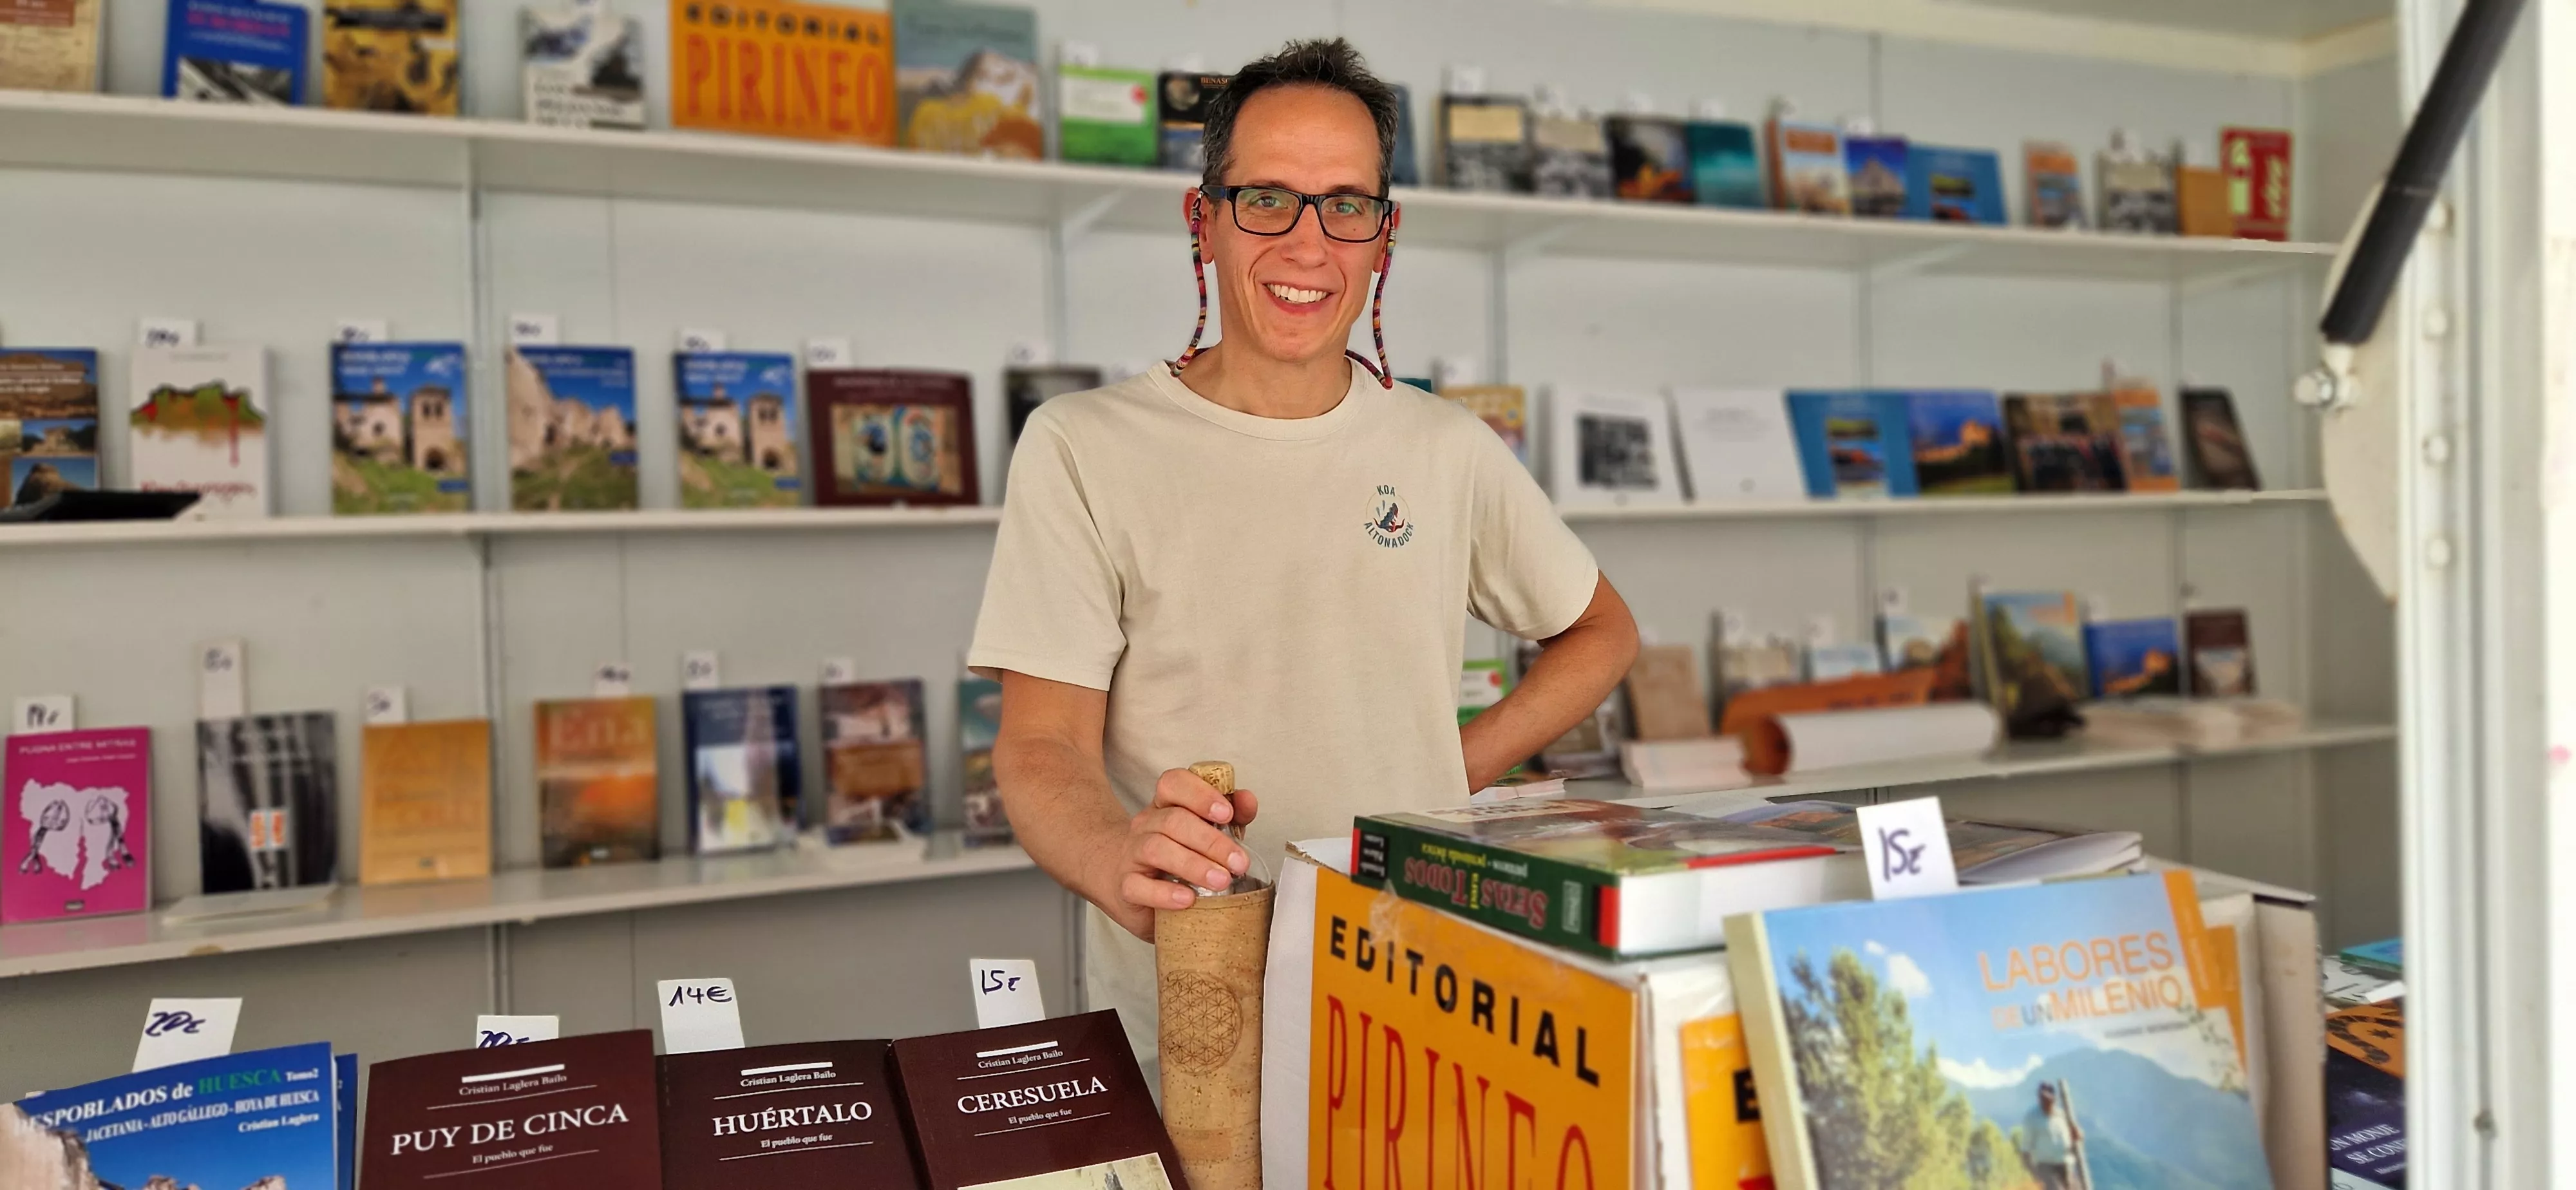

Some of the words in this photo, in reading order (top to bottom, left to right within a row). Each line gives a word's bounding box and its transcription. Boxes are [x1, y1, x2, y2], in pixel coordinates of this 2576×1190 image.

[686, 2, 882, 47] EDITORIAL
[687, 34, 886, 137] PIRINEO
[1376, 484, 1396, 496] KOA
[1363, 522, 1414, 548] ALTONADOCK
[1978, 930, 2175, 992] LABORES
[668, 985, 732, 1007] 14€
[1331, 915, 1599, 1088] EDITORIAL
[978, 1059, 1011, 1069] Cristian
[1012, 1054, 1041, 1064] Laglera
[1043, 1050, 1063, 1059] Bailo
[171, 1082, 193, 1100] de
[198, 1068, 281, 1095] HUESCA
[459, 1083, 500, 1096] Cristian
[503, 1079, 539, 1091] Laglera
[542, 1073, 567, 1084] Bailo
[741, 1075, 777, 1087] Cristian
[779, 1073, 812, 1083] Laglera
[813, 1070, 836, 1080] Bailo
[957, 1076, 1108, 1113] CERESUELA
[1324, 994, 1595, 1190] PIRIN
[86, 1119, 143, 1143] JACETANIA
[148, 1110, 177, 1129] ALTO
[234, 1096, 263, 1114] HOYA
[264, 1094, 279, 1109] DE
[279, 1089, 319, 1107] HUESCA
[238, 1118, 279, 1133] Cristian
[281, 1113, 319, 1127] Laglera
[712, 1101, 872, 1137] HUÉRTALO
[1018, 1113, 1045, 1125] pueblo
[1045, 1111, 1059, 1120] que
[1060, 1108, 1072, 1117] fue
[391, 1126, 461, 1156] PUY
[469, 1119, 516, 1144] DE
[524, 1103, 629, 1136] CINCA
[761, 1140, 770, 1148] El
[772, 1137, 801, 1149] pueblo
[802, 1135, 818, 1145] que
[819, 1133, 833, 1142] fue
[472, 1154, 483, 1164] El
[484, 1149, 517, 1165] pueblo
[518, 1146, 537, 1158] que
[538, 1143, 554, 1153] fue
[2345, 1151, 2375, 1164] SE
